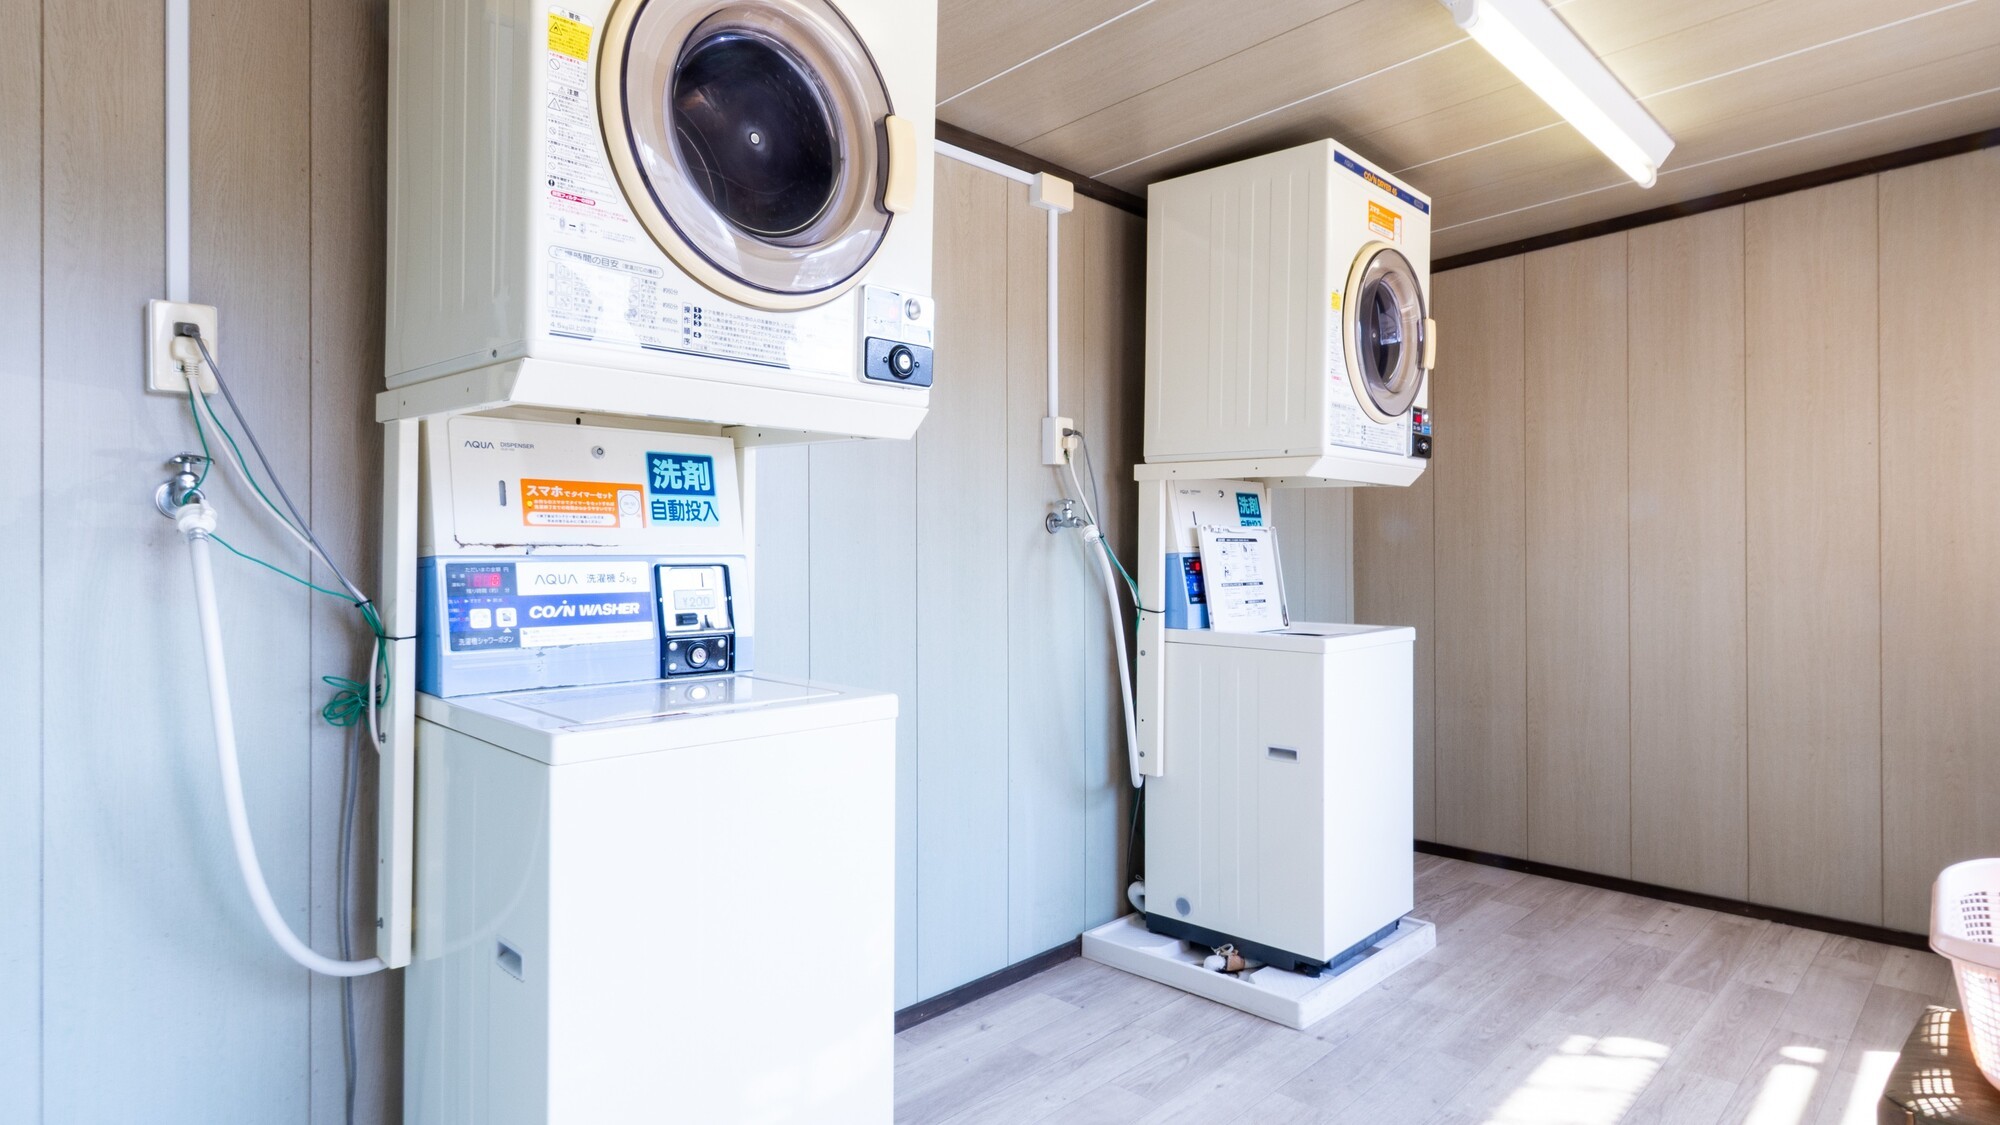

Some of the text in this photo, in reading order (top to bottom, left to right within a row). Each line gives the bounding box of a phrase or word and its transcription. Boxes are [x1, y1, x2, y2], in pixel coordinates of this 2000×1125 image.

[464, 440, 494, 449] AQUA
[653, 458, 711, 491] 洗剤
[526, 485, 613, 499] スマホでタイマーセット
[651, 499, 719, 522] 自動投入
[1239, 496, 1259, 515] 洗剤
[535, 572, 637, 585] AQUA 洗濯機 5kg
[579, 602, 640, 617] WASHER
